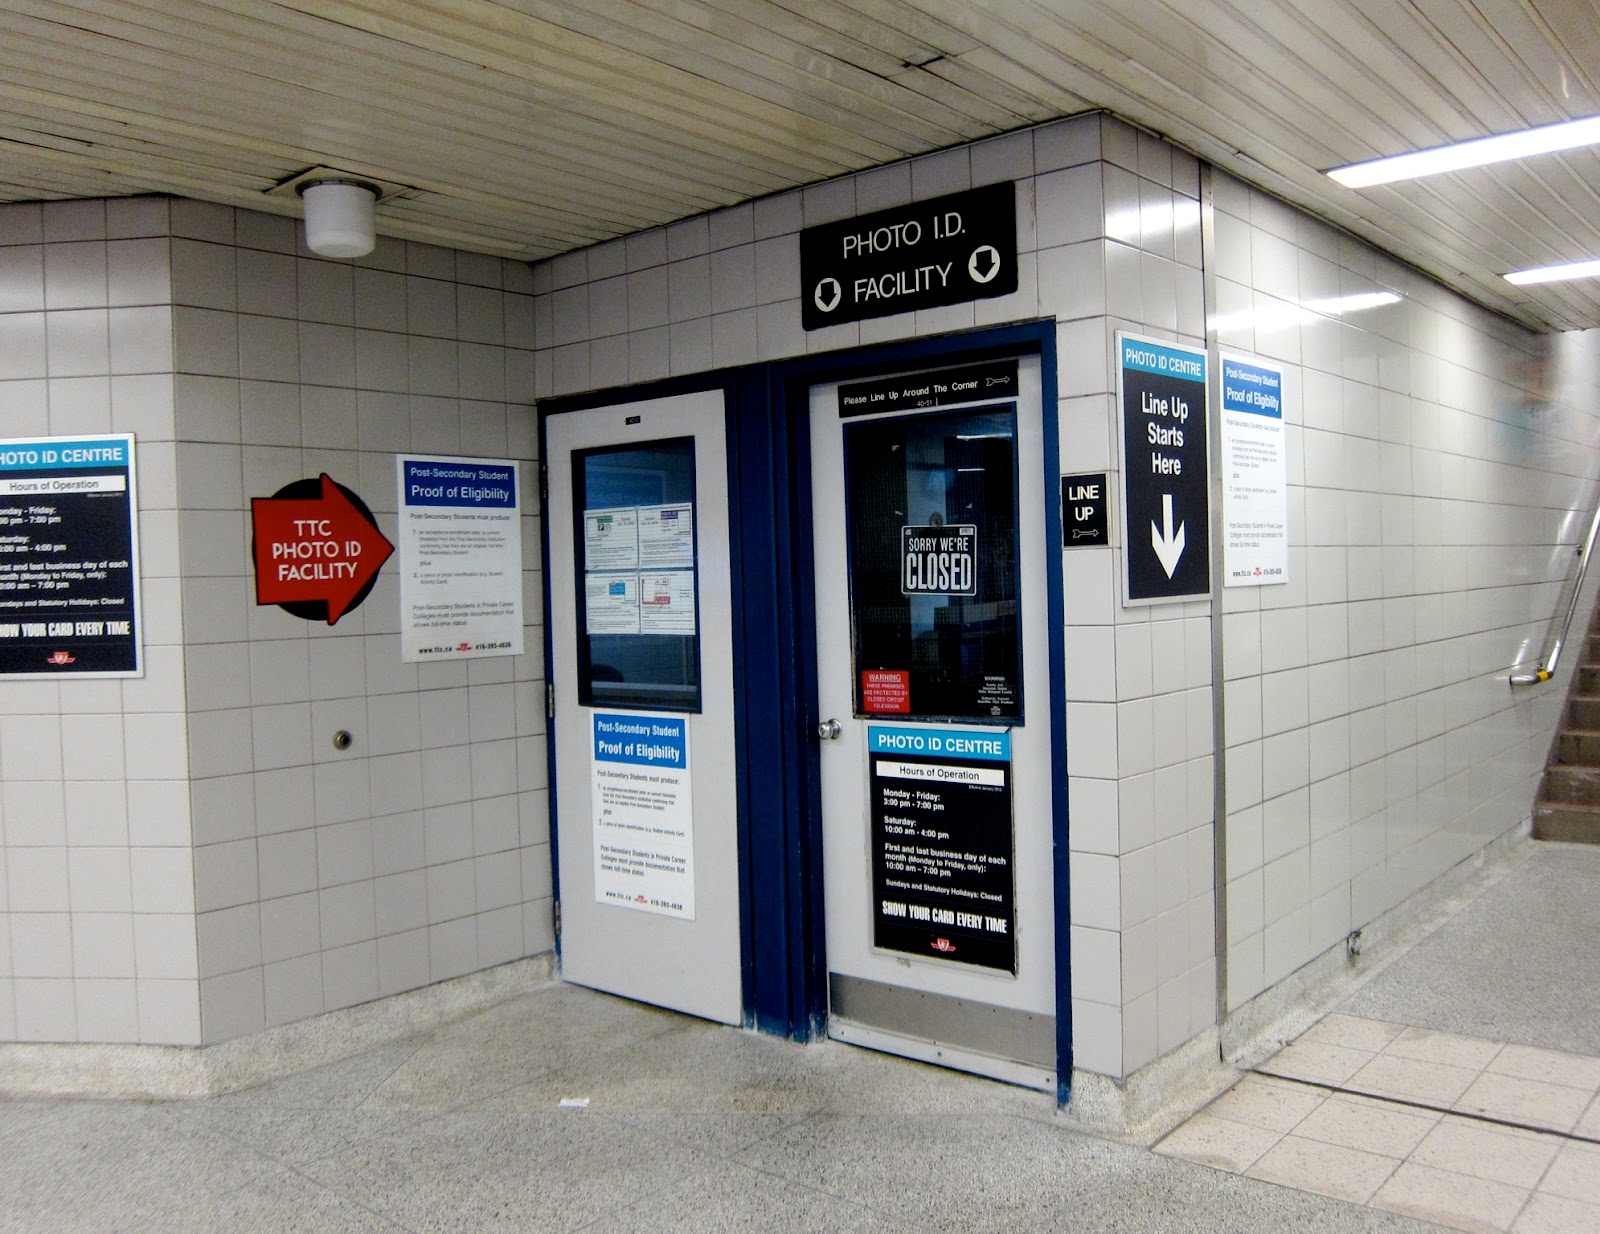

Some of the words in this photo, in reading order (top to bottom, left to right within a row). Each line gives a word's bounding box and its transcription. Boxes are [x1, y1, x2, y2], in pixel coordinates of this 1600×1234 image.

[843, 220, 922, 259] PHOTO
[934, 212, 966, 239] I.D.
[854, 261, 953, 303] FACILITY
[1125, 348, 1157, 368] PHOTO
[1158, 356, 1167, 370] ID
[1168, 358, 1202, 377] CENTRE
[844, 396, 867, 405] Please
[870, 393, 885, 402] Line
[888, 391, 899, 401] Up
[903, 386, 930, 398] Around
[933, 384, 948, 394] The
[951, 380, 978, 391] Corner
[1226, 386, 1246, 403] Proof
[1246, 391, 1254, 404] of
[1253, 392, 1280, 413] Eligibility
[1141, 391, 1168, 416] Line
[1171, 397, 1189, 424] Up
[1147, 422, 1184, 447] Starts
[42, 450, 58, 464] ID
[61, 447, 123, 463] CENTRE
[1151, 452, 1182, 476] Here
[410, 467, 477, 481] Post-Secondary
[478, 470, 509, 480] Student
[10, 481, 38, 492] Hours
[40, 480, 50, 490] of
[53, 480, 99, 491] Operation
[411, 485, 444, 498] Proof
[446, 486, 458, 498] of
[461, 486, 509, 502] Eligibility
[1068, 484, 1100, 501] LINE
[1074, 506, 1095, 521] UP
[293, 519, 332, 537] TTC
[272, 541, 339, 559] PHOTO
[345, 541, 361, 557] ID
[908, 537, 937, 551] SORRY
[940, 537, 969, 551] WE'RE
[278, 562, 357, 581] FACILITY
[906, 552, 972, 590] CLOSED
[21, 623, 46, 638] YOUR
[48, 622, 74, 637] CARD
[75, 621, 104, 637] EVERY
[106, 620, 130, 635] TIME
[868, 674, 901, 682] WARNING
[598, 721, 650, 737] Post-Secondary
[652, 725, 679, 737] Student
[598, 740, 622, 754] Proof
[625, 743, 634, 756] of
[637, 744, 680, 763] Eligibility
[878, 734, 924, 750] PHOTO
[928, 737, 942, 751] ID
[945, 738, 1003, 755] CENTRE
[900, 766, 924, 776] Hours
[927, 768, 935, 777] of
[938, 769, 980, 780] Operation
[883, 788, 910, 800] Monday
[917, 791, 941, 802] Friday:
[883, 798, 898, 807] 3:00
[900, 800, 910, 808] pm
[917, 801, 931, 809] 7:00
[933, 803, 944, 812] pm
[884, 816, 917, 828] Saturday:
[885, 825, 903, 834] 10:00
[921, 829, 936, 838] 4:00
[938, 831, 949, 840] pm
[885, 843, 900, 852] First
[902, 845, 914, 854] and
[916, 846, 930, 856] last
[931, 848, 962, 860] business
[964, 852, 977, 863] day
[979, 854, 987, 863] of
[988, 856, 1007, 866] each
[885, 853, 906, 862] month
[908, 854, 935, 866] (Monday
[936, 858, 943, 867] to
[944, 860, 966, 871] Friday,
[967, 862, 987, 873] only):
[886, 861, 904, 870] 10:00
[905, 865, 916, 873] am
[923, 866, 938, 875] 7:00
[940, 869, 951, 878] pm
[886, 878, 910, 889] Sundays
[911, 882, 923, 890] and
[923, 883, 950, 895] Statutory
[951, 887, 979, 899] Holidays:
[980, 891, 1003, 902] Closed
[882, 900, 907, 917] SHOW
[908, 904, 931, 921] YOUR
[932, 907, 955, 925] CARD
[956, 911, 983, 929] EVERY
[984, 915, 1007, 934] TIME
